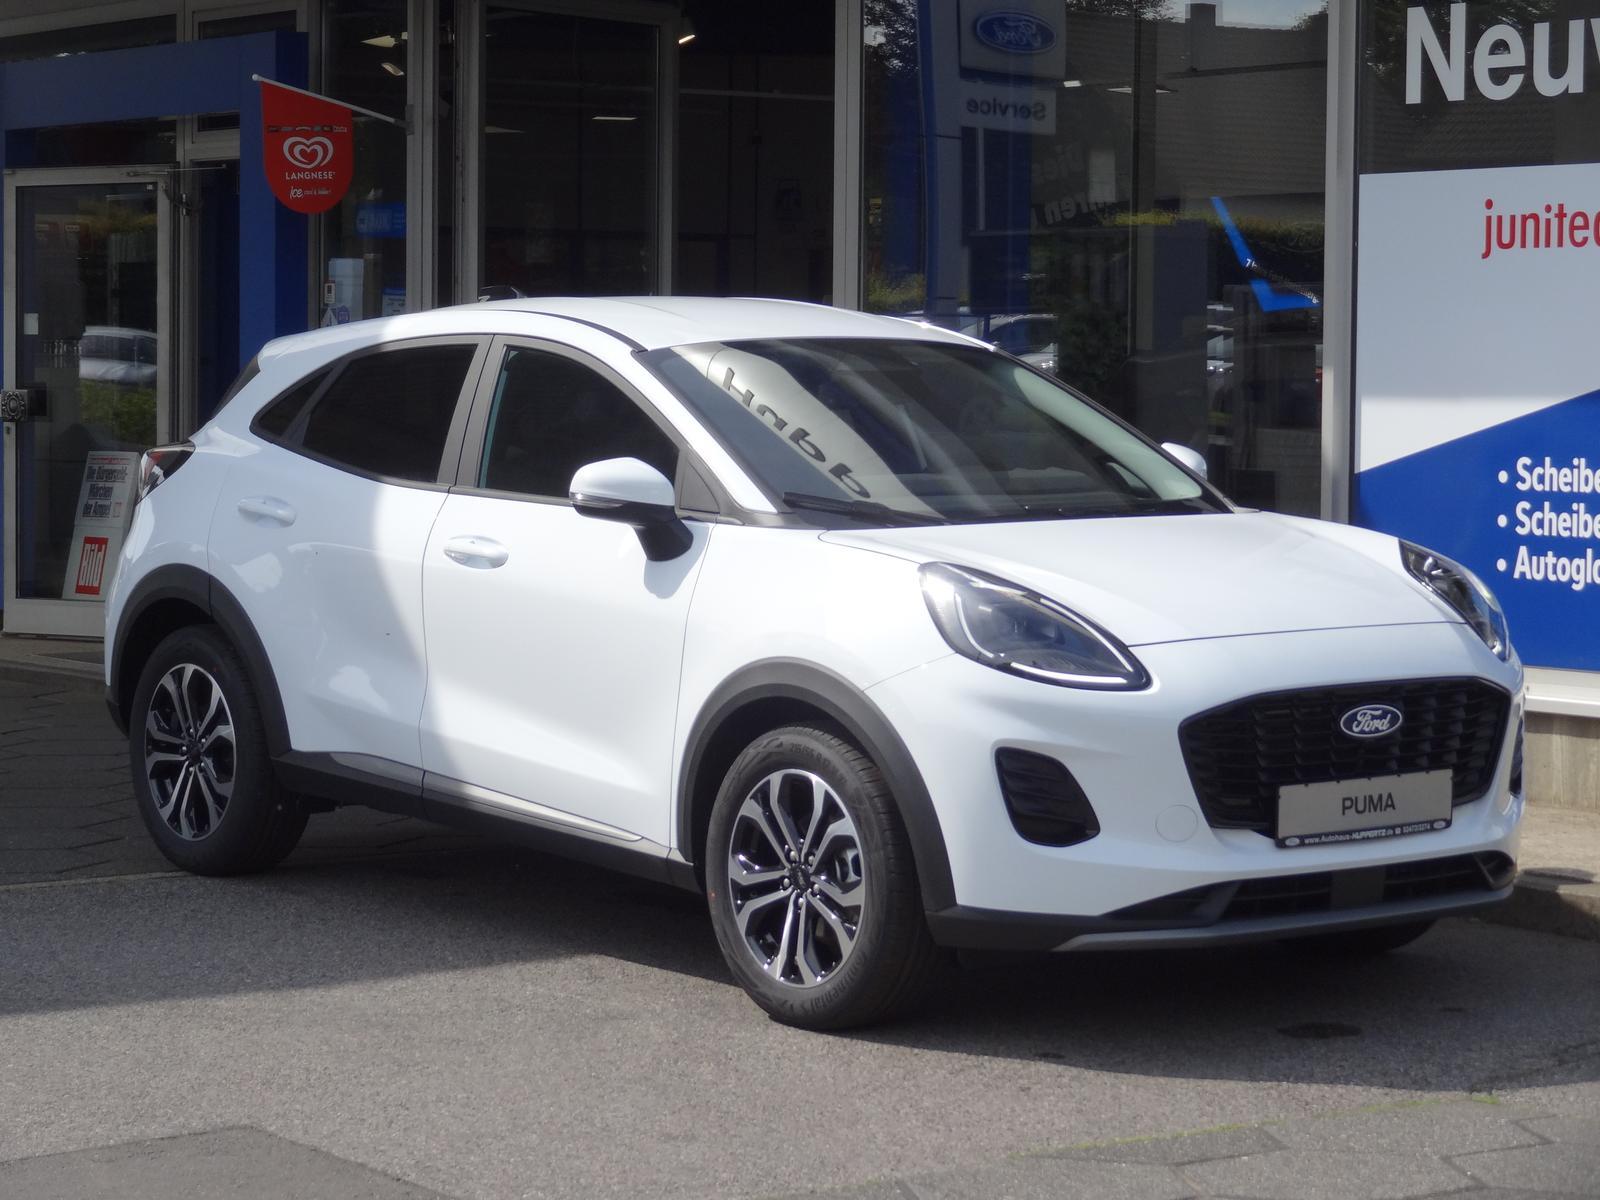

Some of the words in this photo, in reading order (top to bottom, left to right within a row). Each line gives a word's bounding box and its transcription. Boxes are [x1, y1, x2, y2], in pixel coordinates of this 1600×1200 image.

[1404, 3, 1600, 104] Neu
[285, 171, 333, 180] LANGNESE
[1352, 709, 1391, 733] Ford
[1341, 791, 1396, 816] PUMA
